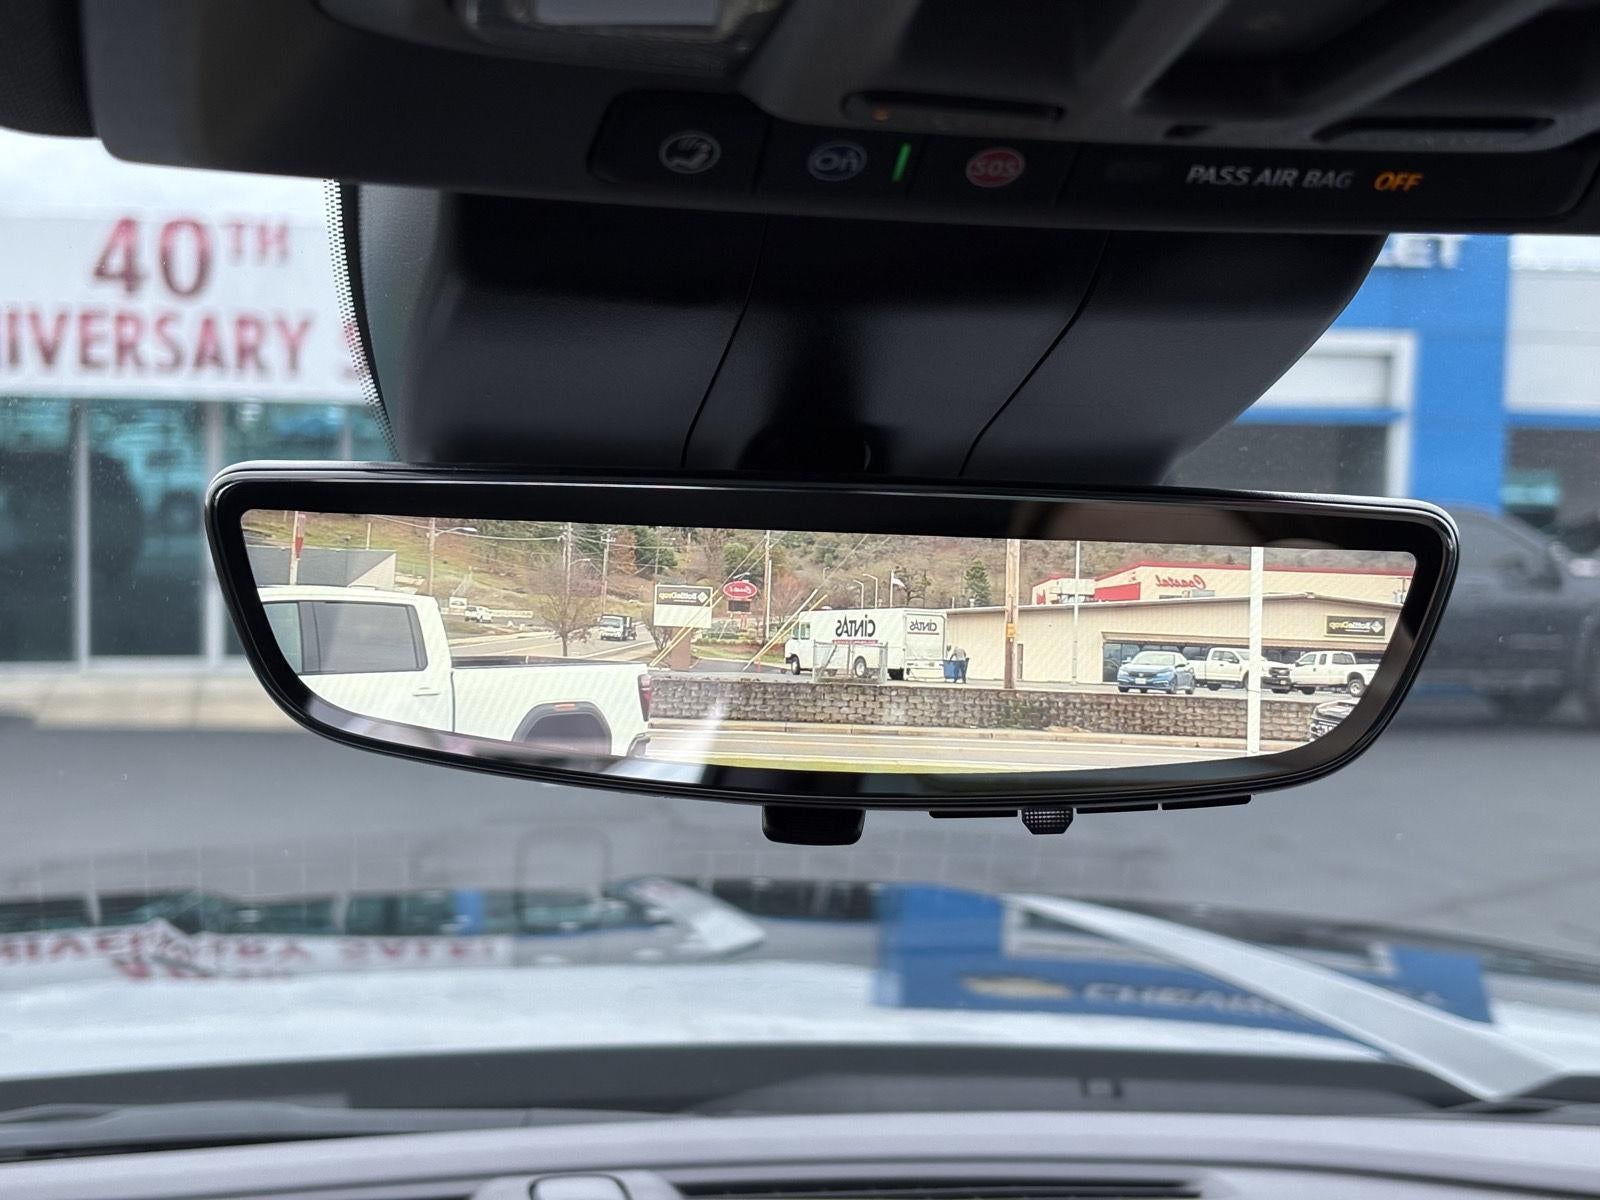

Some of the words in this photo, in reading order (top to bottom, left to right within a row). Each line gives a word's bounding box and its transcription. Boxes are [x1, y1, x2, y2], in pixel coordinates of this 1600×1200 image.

[972, 158, 1017, 177] SOS
[1186, 165, 1252, 187] PASS
[1252, 168, 1296, 188] AIR
[1302, 169, 1354, 190] BAG
[1373, 171, 1424, 192] OFF
[0, 309, 314, 376] IVERSARY
